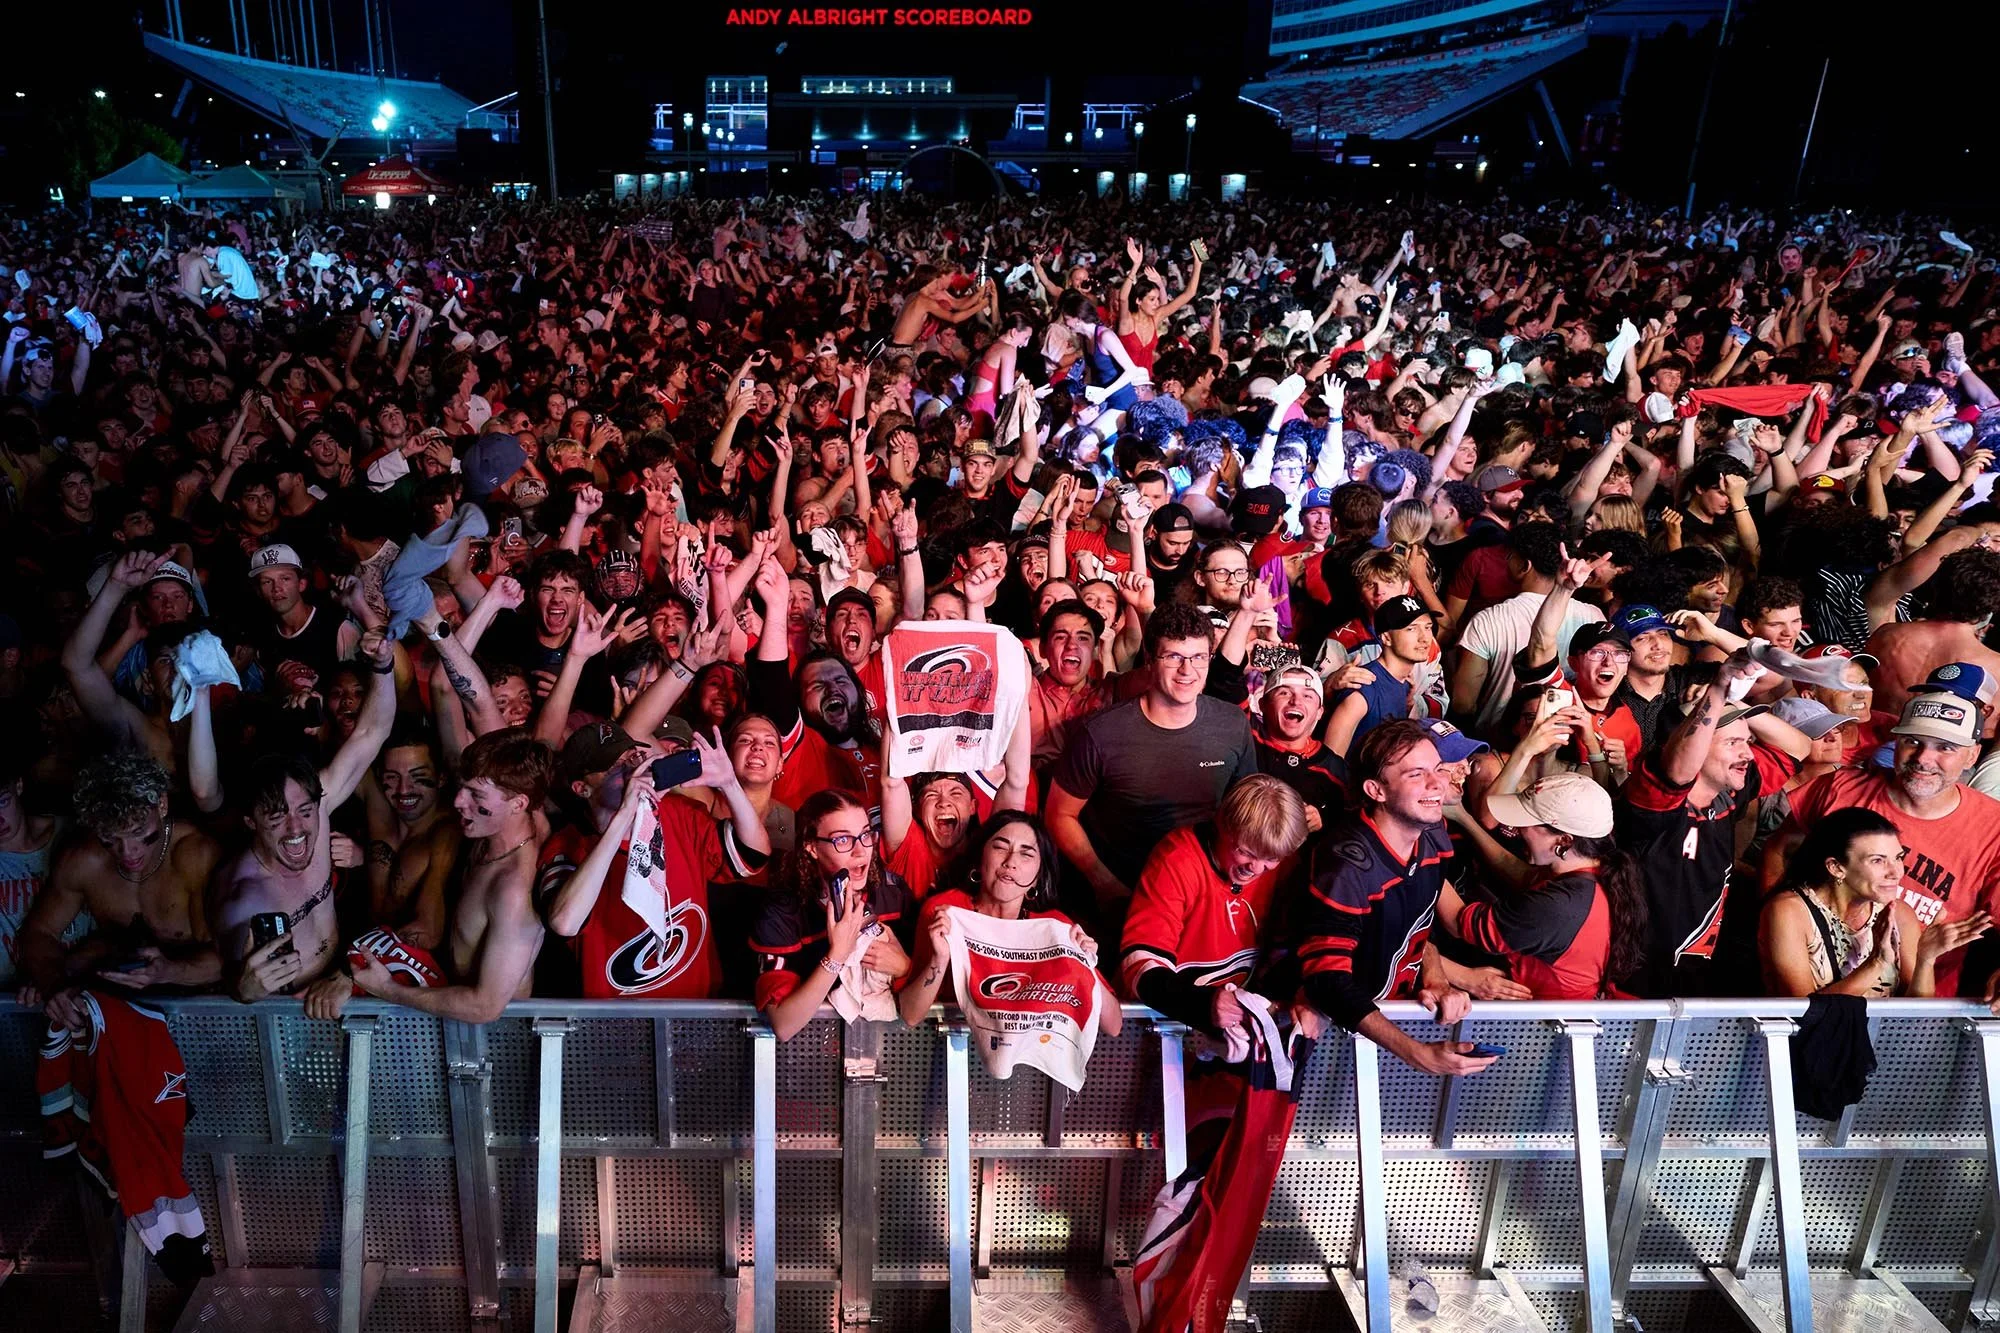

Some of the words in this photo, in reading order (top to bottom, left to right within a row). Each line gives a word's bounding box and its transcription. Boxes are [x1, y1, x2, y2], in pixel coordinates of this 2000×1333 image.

[726, 9, 782, 25] ANDY
[787, 9, 888, 25] ALBRIGHT
[894, 9, 1032, 25] SCOREBOARD
[1402, 597, 1420, 612] NY
[902, 684, 925, 702] IT
[1682, 826, 1699, 861] A
[1001, 950, 1038, 961] SOUTHEAST
[1038, 947, 1066, 960] DIVISION
[997, 1012, 1020, 1021] RECORD
[1021, 1013, 1028, 1021] IN
[1004, 1022, 1018, 1030] BEST
